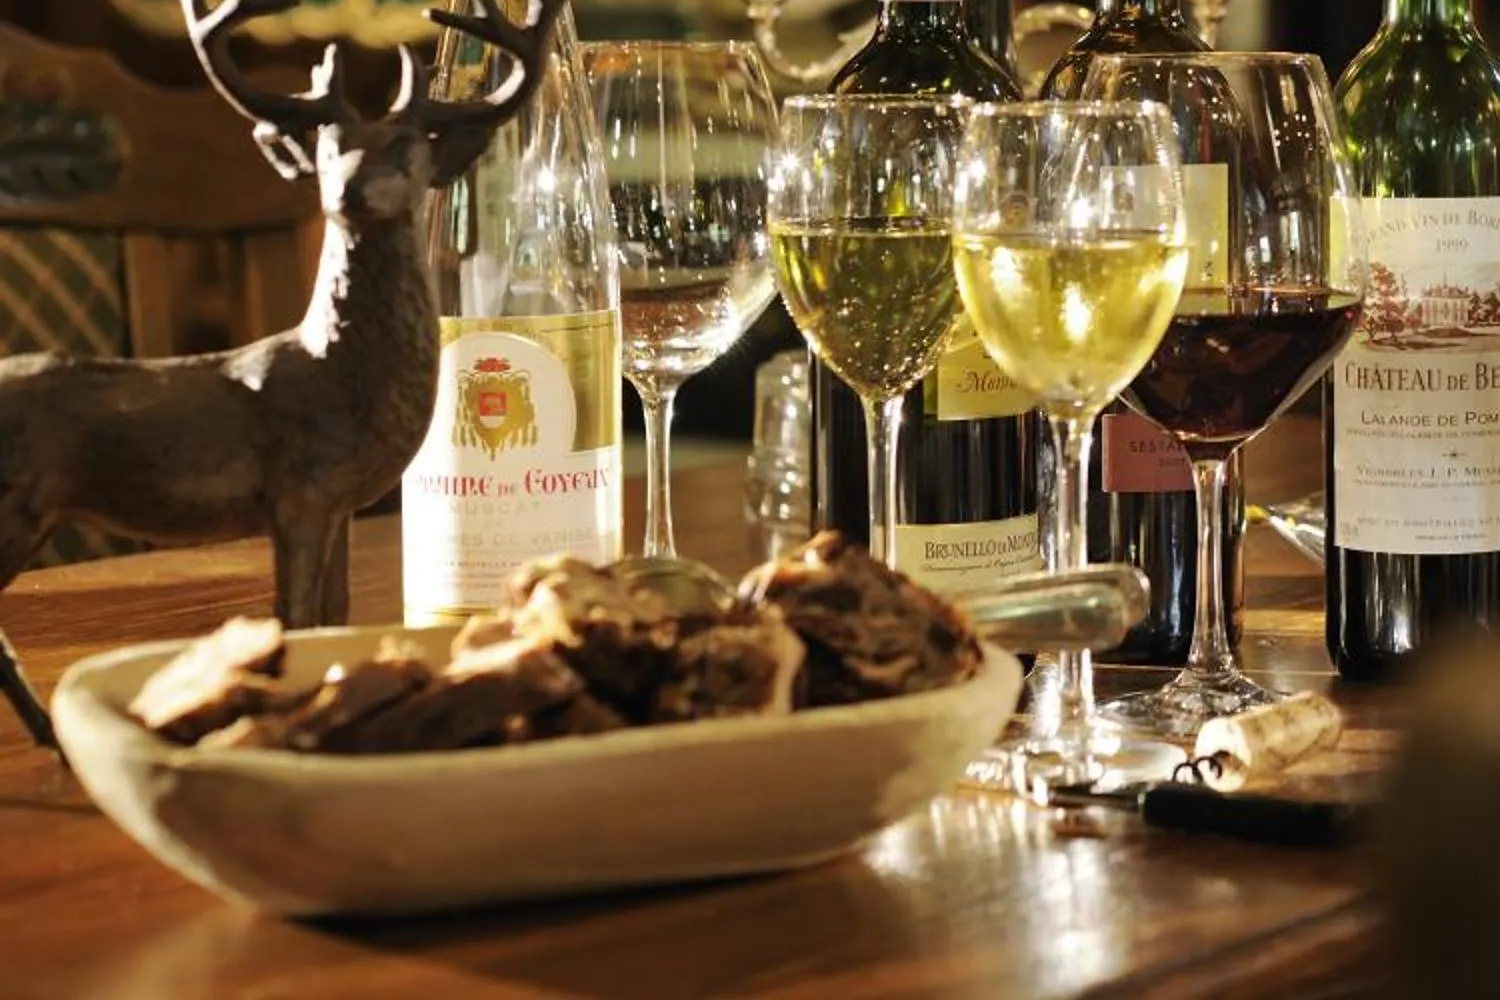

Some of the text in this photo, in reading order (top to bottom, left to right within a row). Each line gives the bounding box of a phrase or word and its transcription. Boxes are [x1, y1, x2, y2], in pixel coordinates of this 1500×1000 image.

[1345, 362, 1441, 392] CHÂTEAU
[1447, 373, 1470, 391] DE
[1361, 410, 1432, 427] LALANDE
[1437, 414, 1459, 427] DE
[925, 538, 995, 560] BRUNELLO
